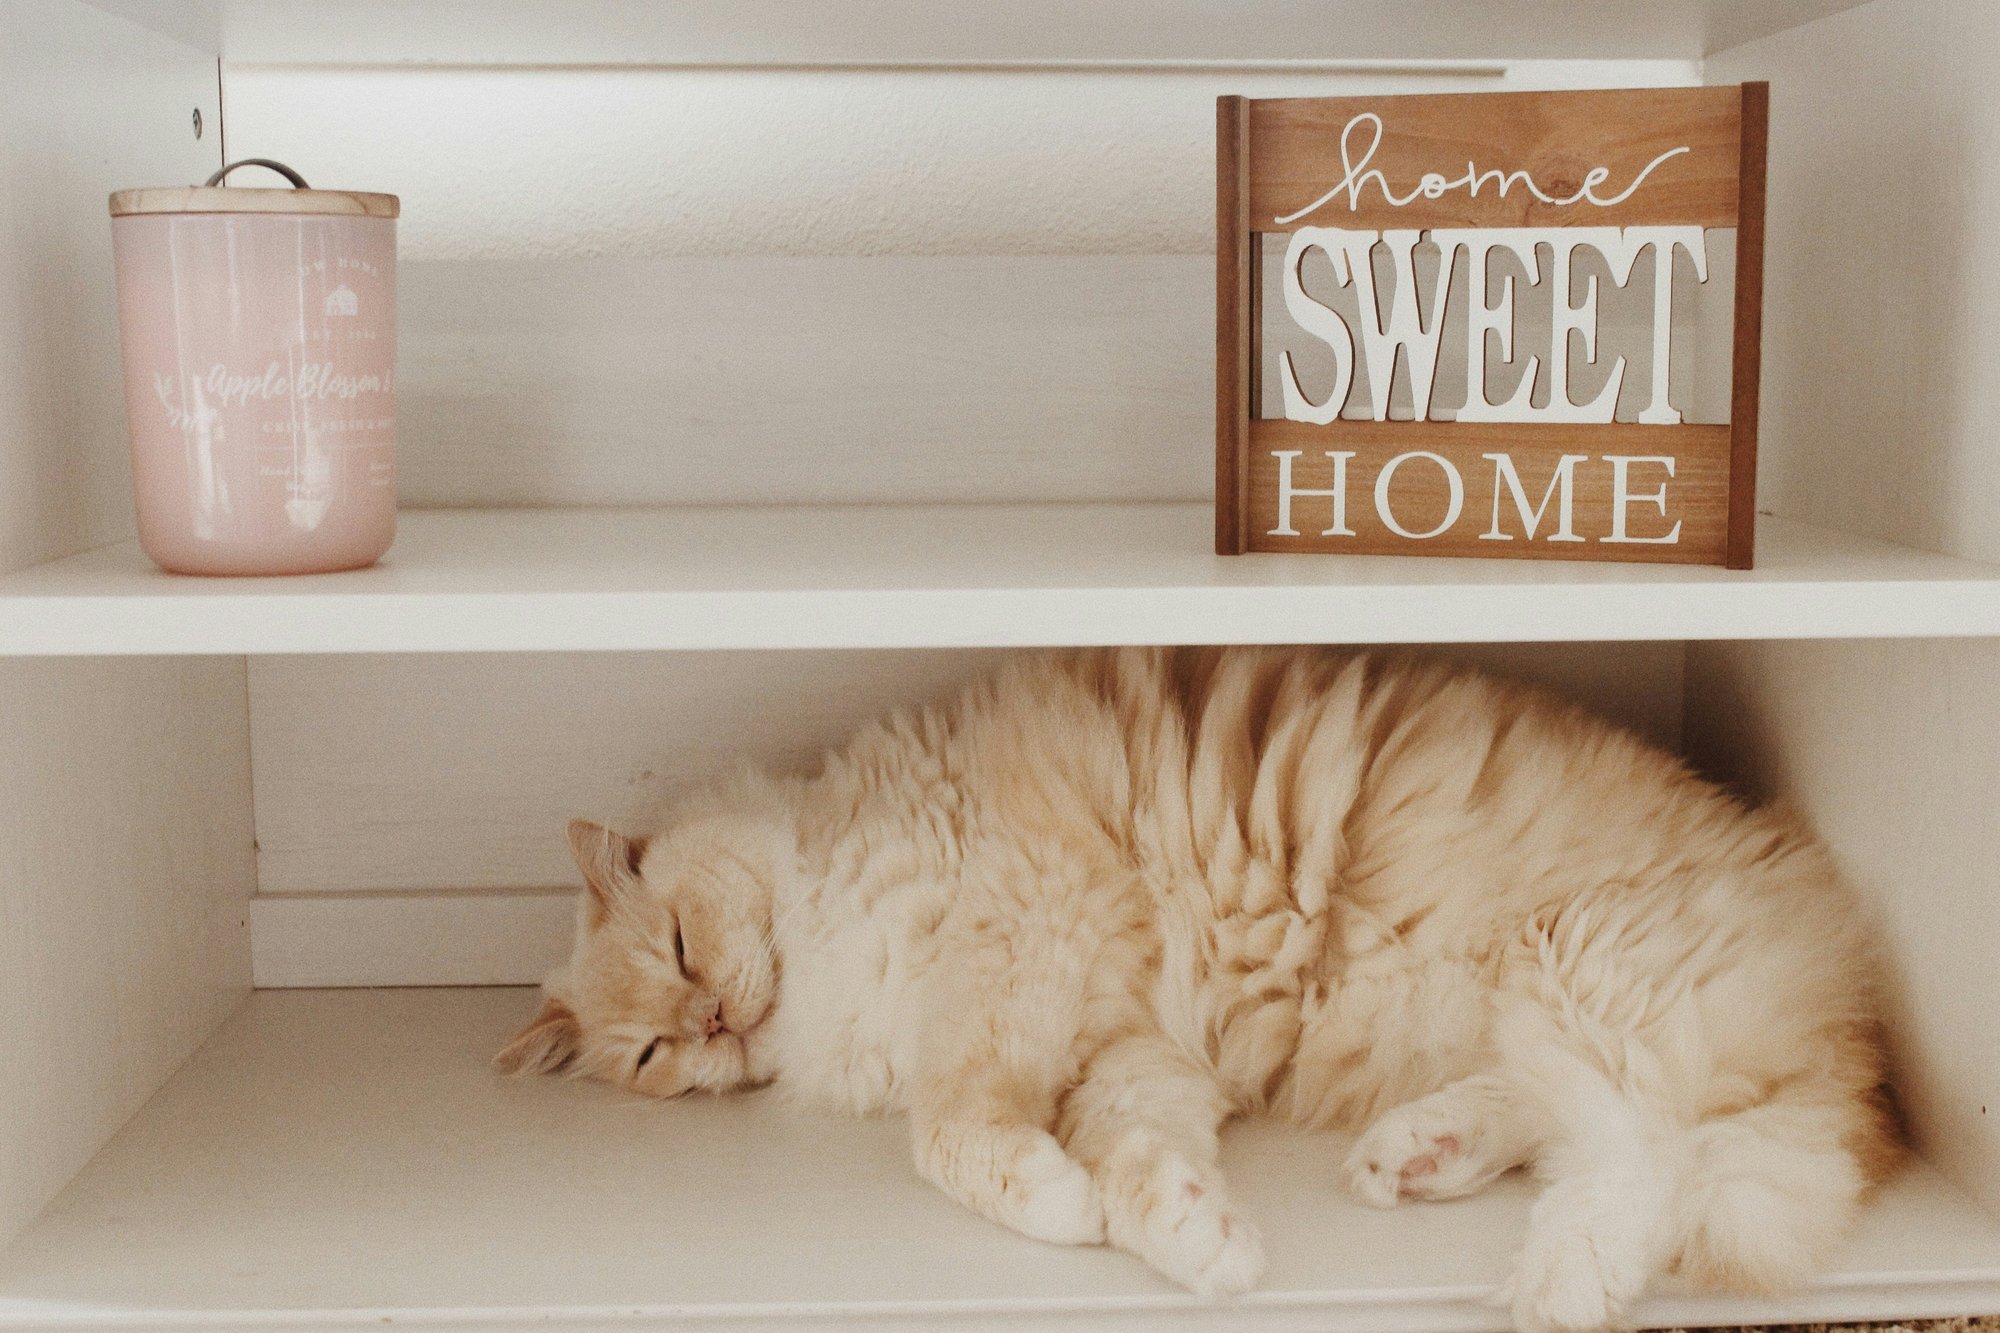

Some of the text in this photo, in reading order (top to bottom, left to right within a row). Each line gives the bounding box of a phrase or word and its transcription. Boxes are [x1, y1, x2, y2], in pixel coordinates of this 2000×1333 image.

[1274, 112, 1690, 225] home
[1279, 225, 1708, 426] SWEET
[206, 361, 289, 407] Apple
[1266, 450, 1682, 545] HOME
